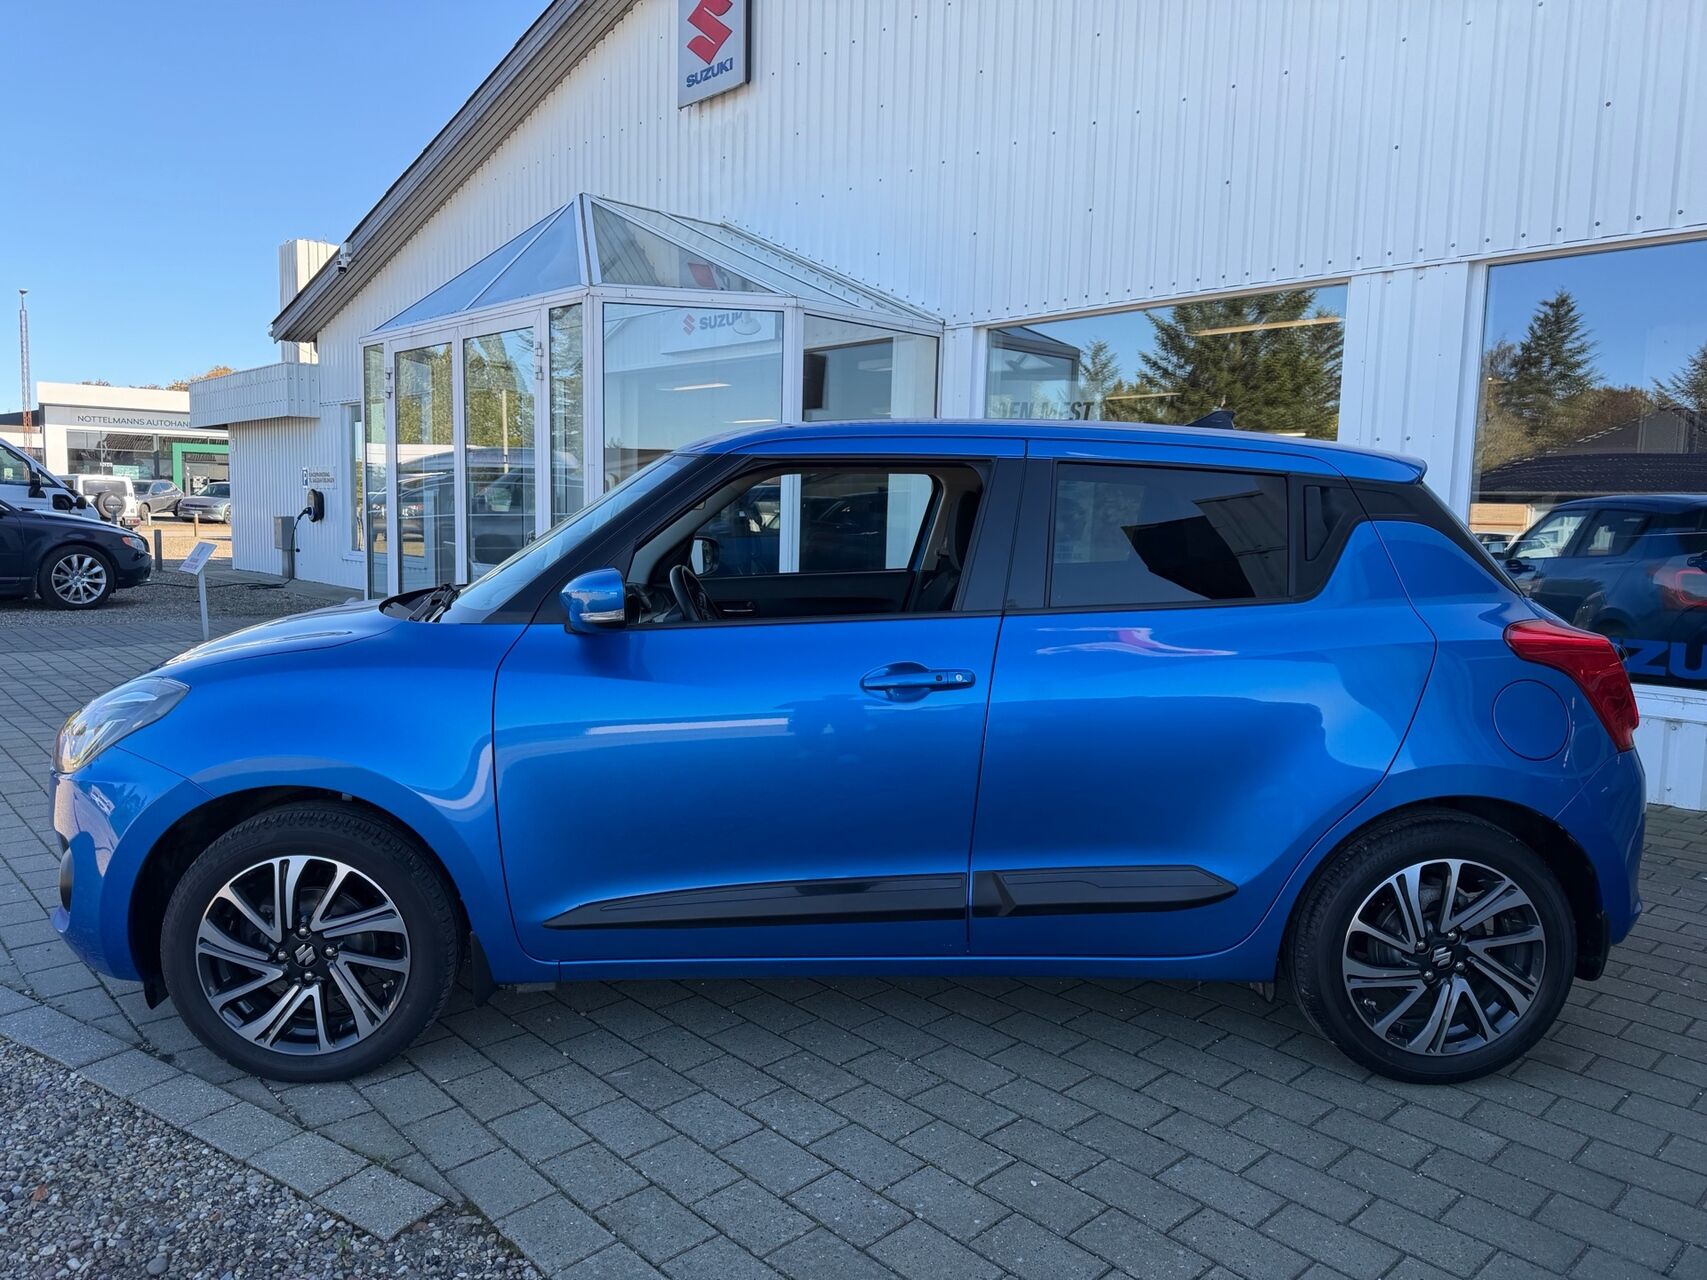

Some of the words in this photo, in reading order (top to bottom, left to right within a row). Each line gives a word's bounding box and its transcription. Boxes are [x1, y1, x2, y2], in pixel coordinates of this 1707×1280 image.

[686, 57, 733, 88] SUZUKI
[77, 415, 145, 426] NOTTELMANNS
[146, 419, 191, 428] AUTOHAN
